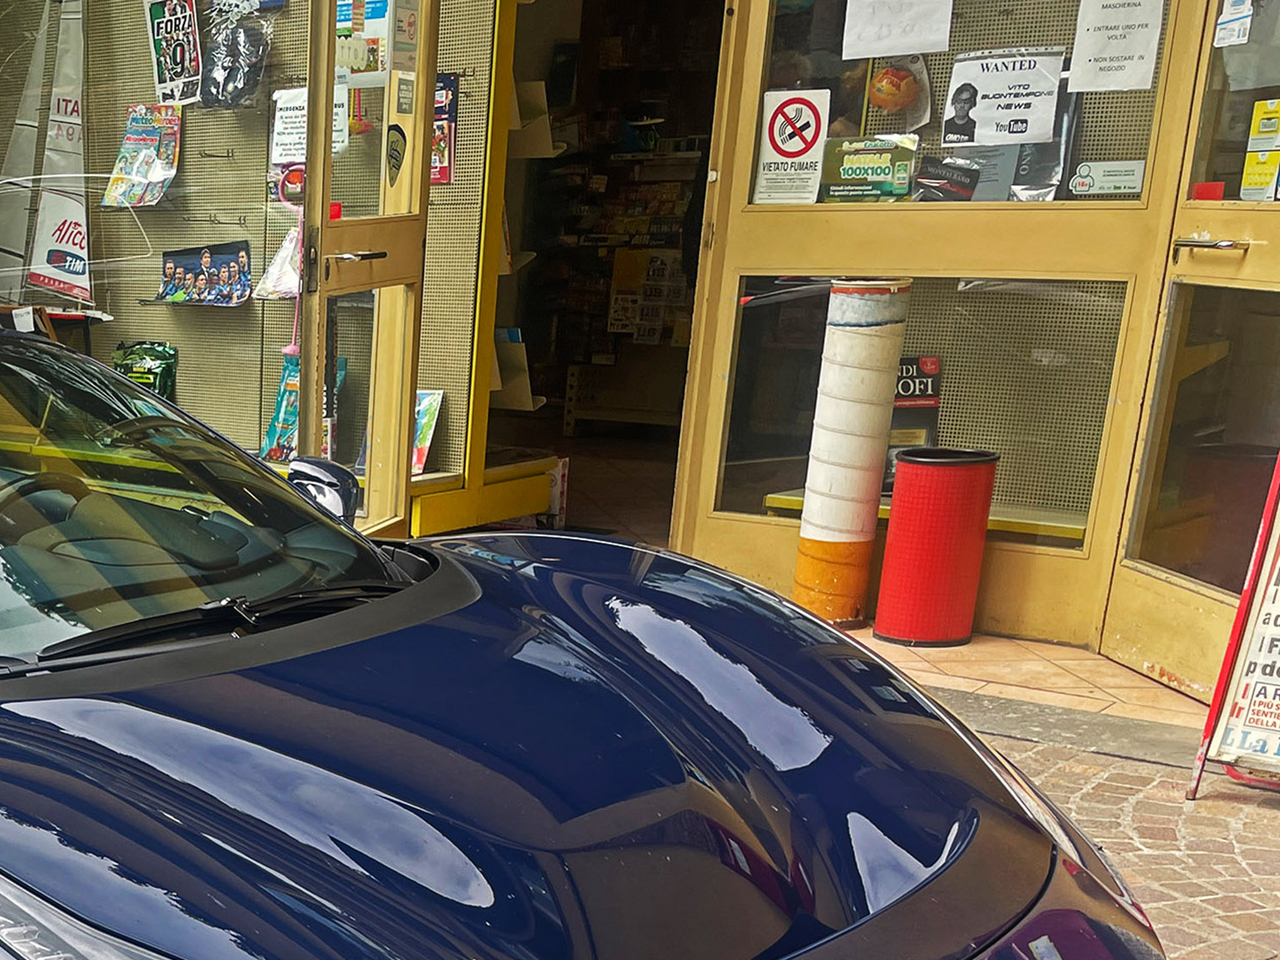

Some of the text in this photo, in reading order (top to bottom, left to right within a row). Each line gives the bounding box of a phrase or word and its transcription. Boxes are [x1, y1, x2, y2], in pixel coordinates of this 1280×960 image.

[1101, 2, 1142, 10] MASCHERINA
[155, 12, 193, 38] FORZA
[1106, 33, 1127, 41] VOLTA
[171, 41, 186, 79] 9
[1108, 55, 1135, 63] SOSTARE
[980, 59, 1037, 73] WANTED
[1007, 83, 1031, 91] VITO
[56, 97, 81, 117] ITA
[996, 101, 1033, 111] NEWS
[995, 118, 1029, 134] YouTube
[843, 153, 892, 166] NATALE
[762, 160, 819, 172] VIETATO FUMARE
[841, 165, 892, 177] 100X100
[64, 255, 85, 273] TIM
[1257, 700, 1274, 710] PIÙ
[1247, 717, 1277, 729] DELLA
